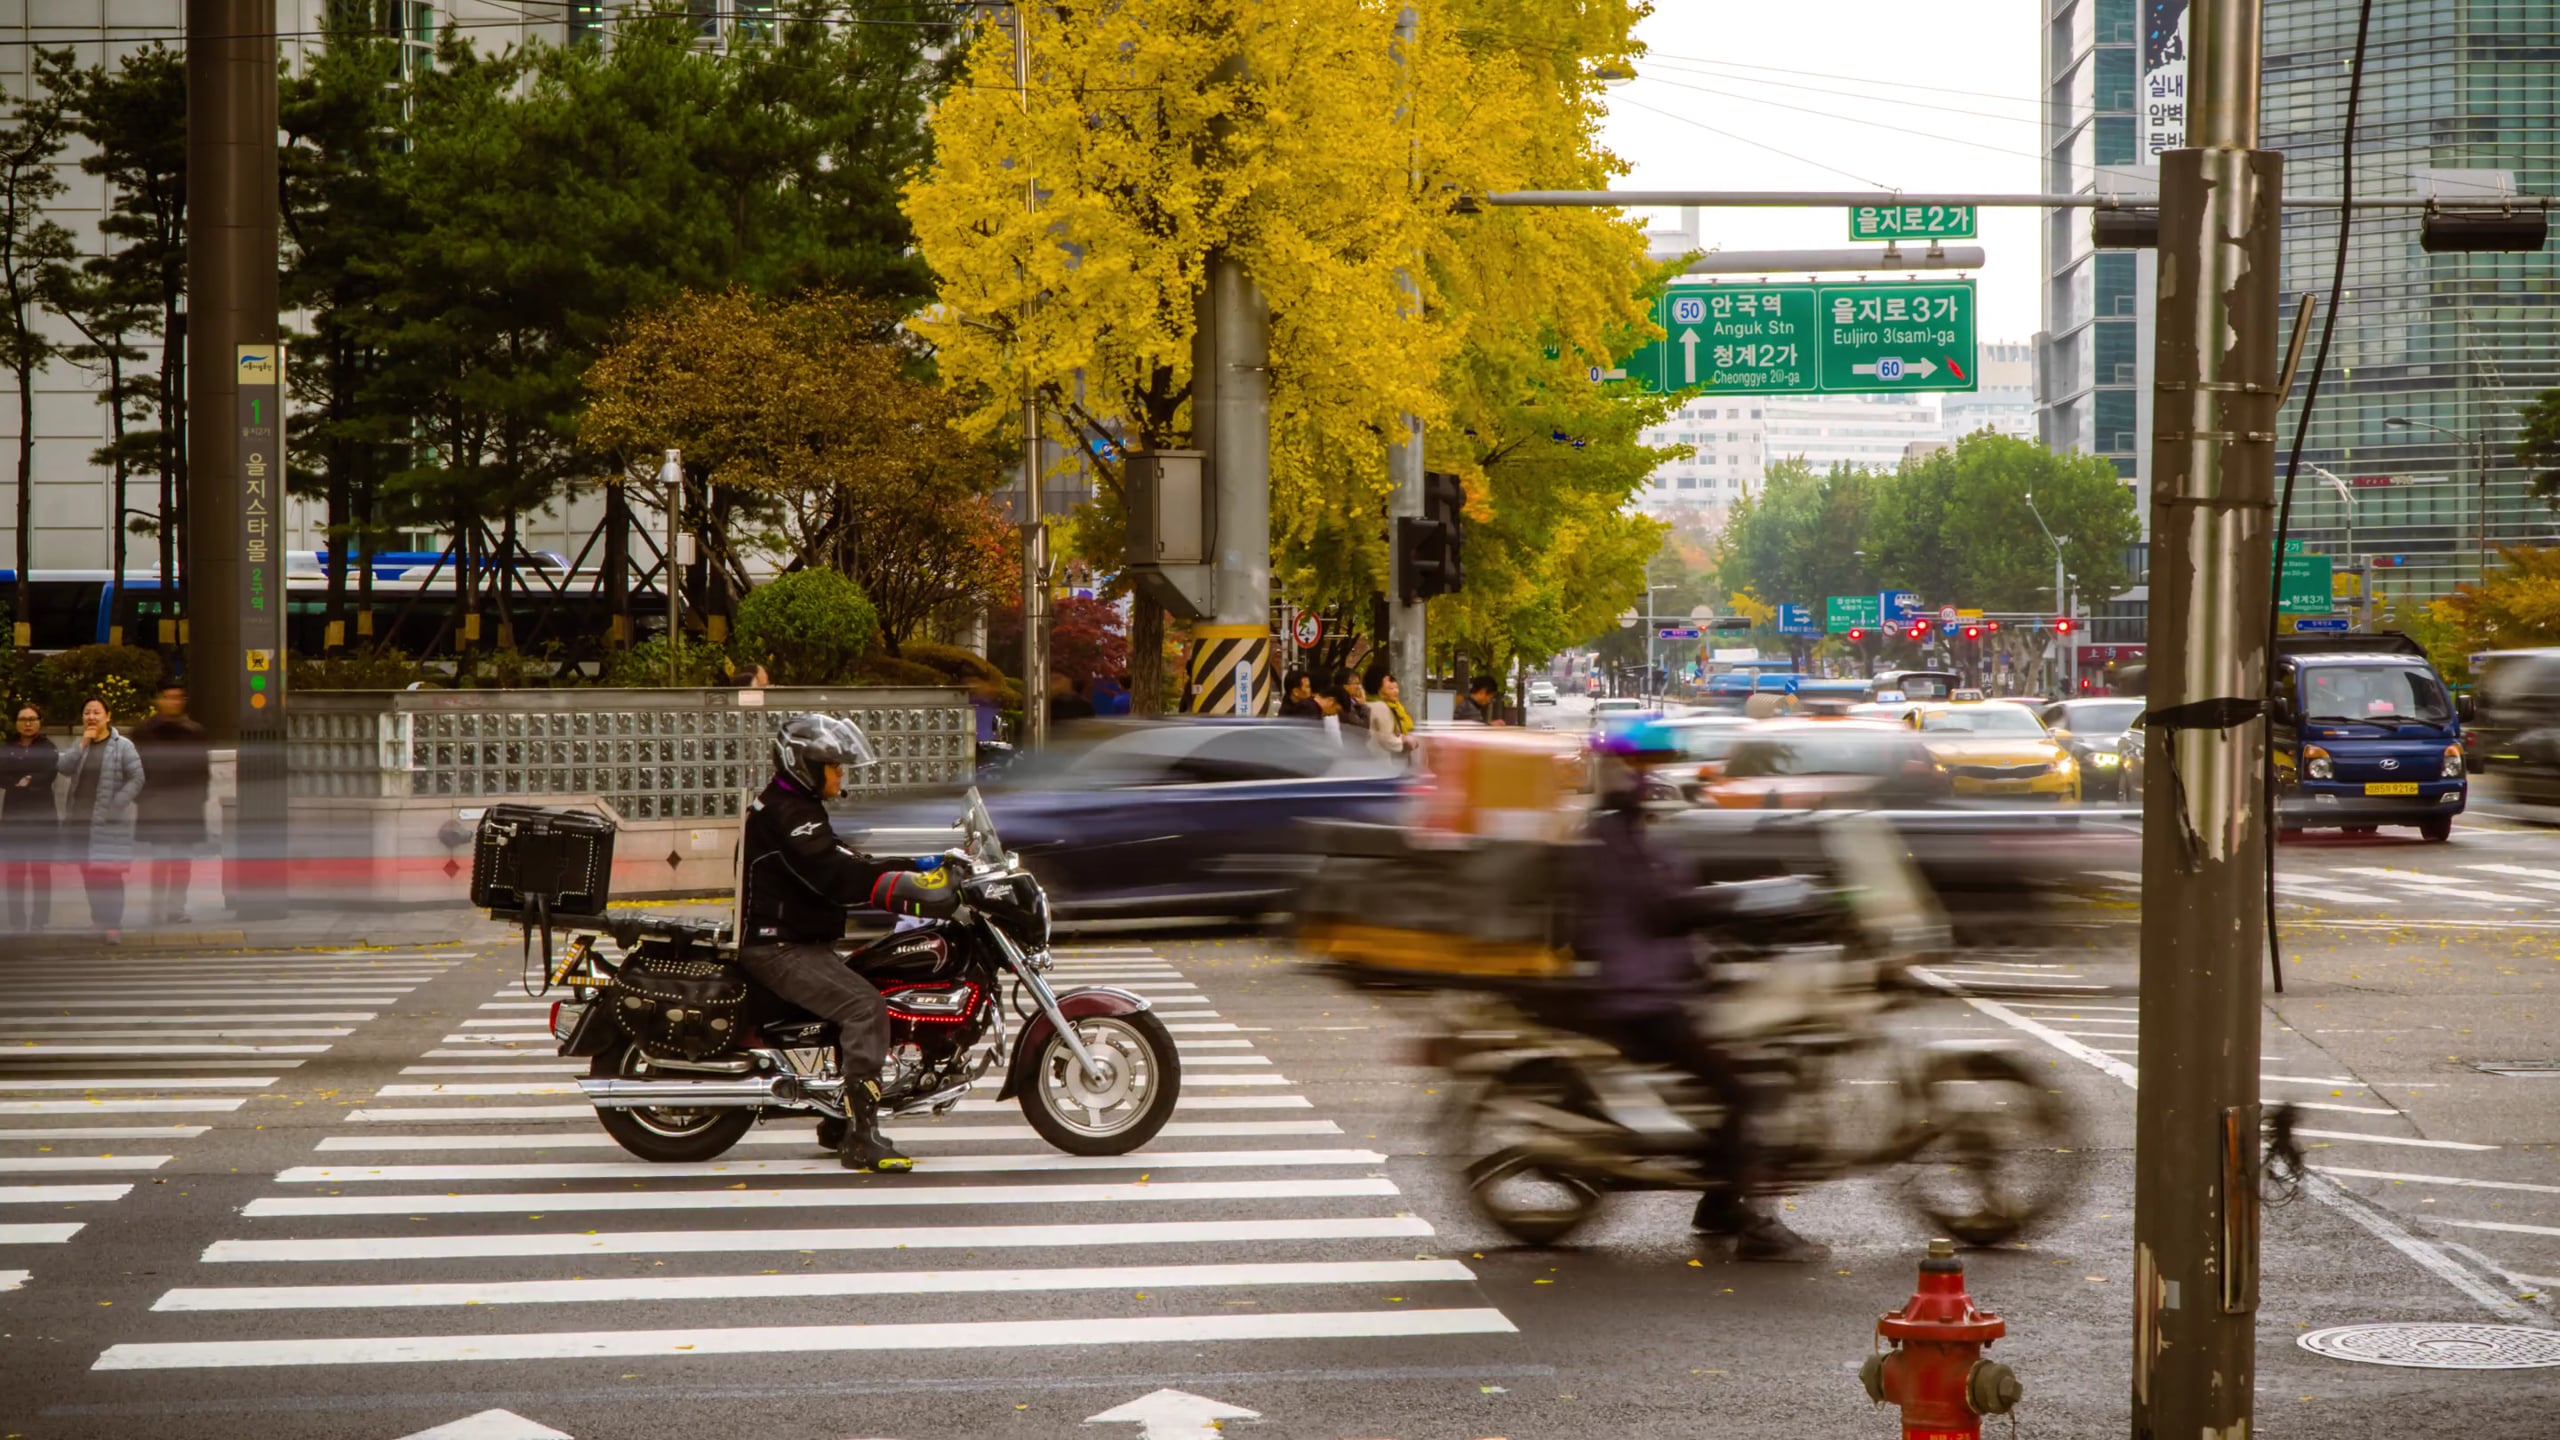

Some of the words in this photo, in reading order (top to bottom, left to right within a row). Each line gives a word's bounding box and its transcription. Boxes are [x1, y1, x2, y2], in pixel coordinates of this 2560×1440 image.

[2149, 74, 2184, 98] 실내
[2149, 104, 2184, 127] 암벽
[1857, 206, 1970, 234] 을지로2가
[1680, 300, 1700, 319] 50
[1710, 294, 1782, 318] 안국역
[1831, 295, 1959, 324] 을지로3가
[1713, 321, 1763, 337] Anguk
[1769, 320, 1794, 334] Stn
[1833, 327, 1878, 348] Euljiro
[1882, 327, 1956, 346] 3(sam)-ga
[1713, 343, 1798, 368] 청계2가
[1713, 369, 1767, 387] Cheonggye
[1881, 361, 1900, 377] 60
[251, 399, 261, 425] 1
[245, 452, 269, 562] 을지스타몰
[1943, 610, 1954, 618] 60
